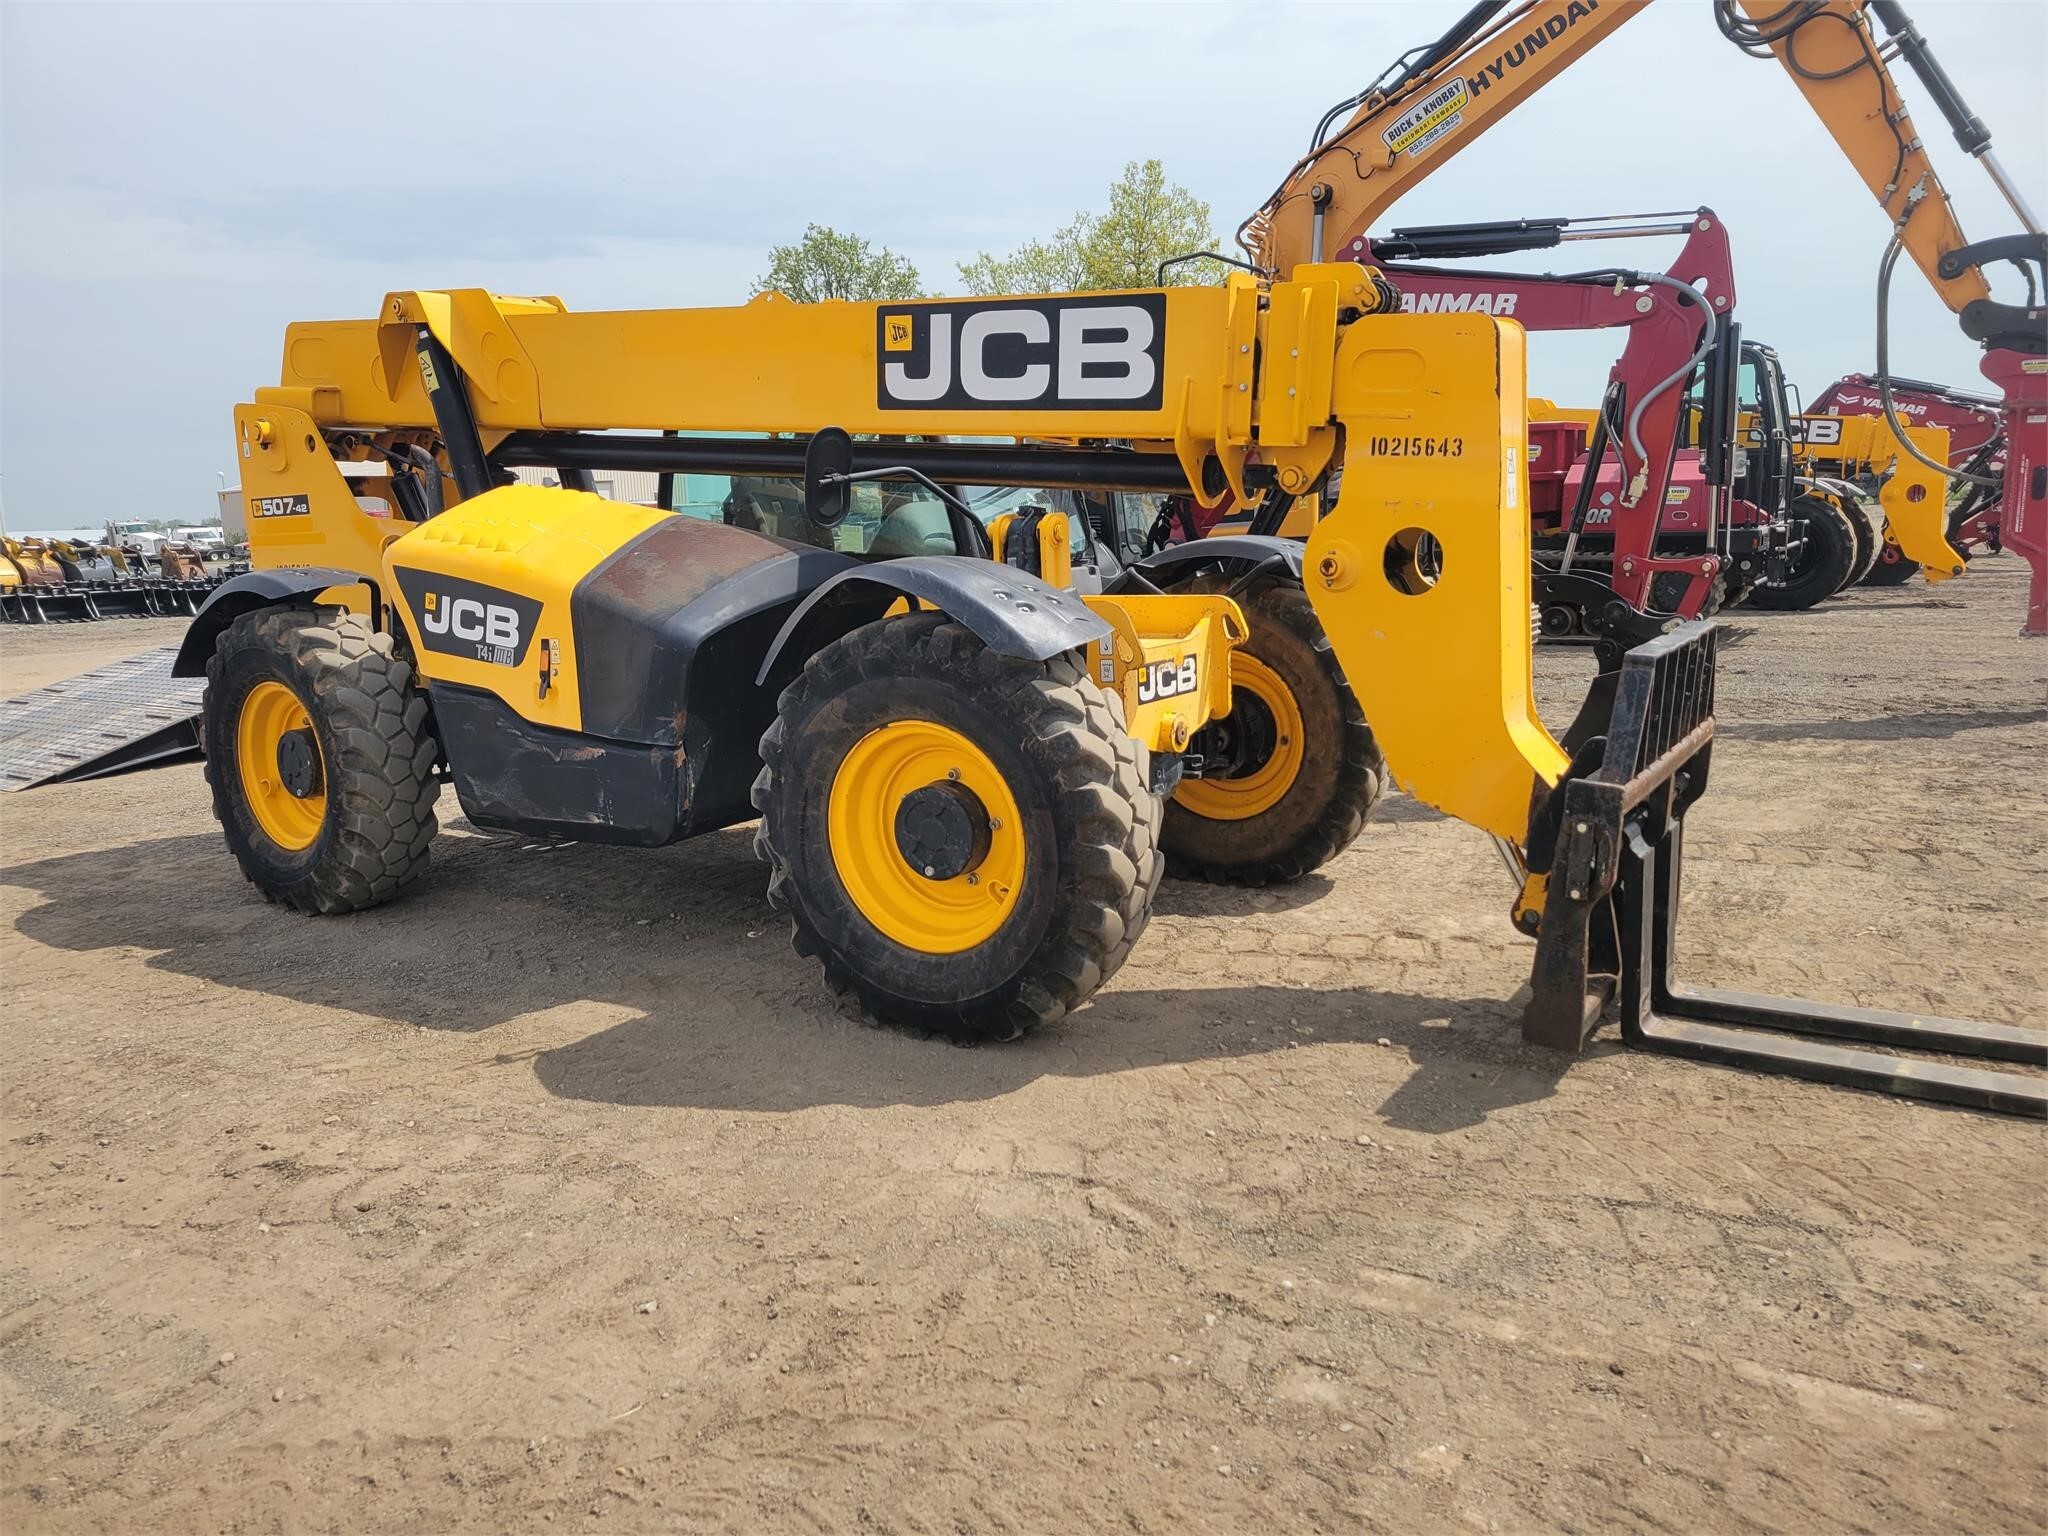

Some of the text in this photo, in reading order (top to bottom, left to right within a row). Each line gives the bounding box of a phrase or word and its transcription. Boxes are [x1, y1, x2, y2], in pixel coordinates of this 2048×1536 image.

[1388, 117, 1414, 142] BUCK
[1414, 113, 1423, 122] &
[1422, 82, 1461, 116] KNOBBY
[1397, 120, 1431, 147] Equipment
[1431, 98, 1461, 122] Company
[1408, 113, 1460, 153] 855-288-2825
[1400, 293, 1518, 315] ANMAR
[885, 306, 1155, 401] JCB
[891, 324, 908, 342] JCB
[1371, 437, 1463, 457] 10215643
[424, 595, 519, 648] JCB
[476, 643, 492, 662] T4i
[1139, 657, 1196, 702] JCB
